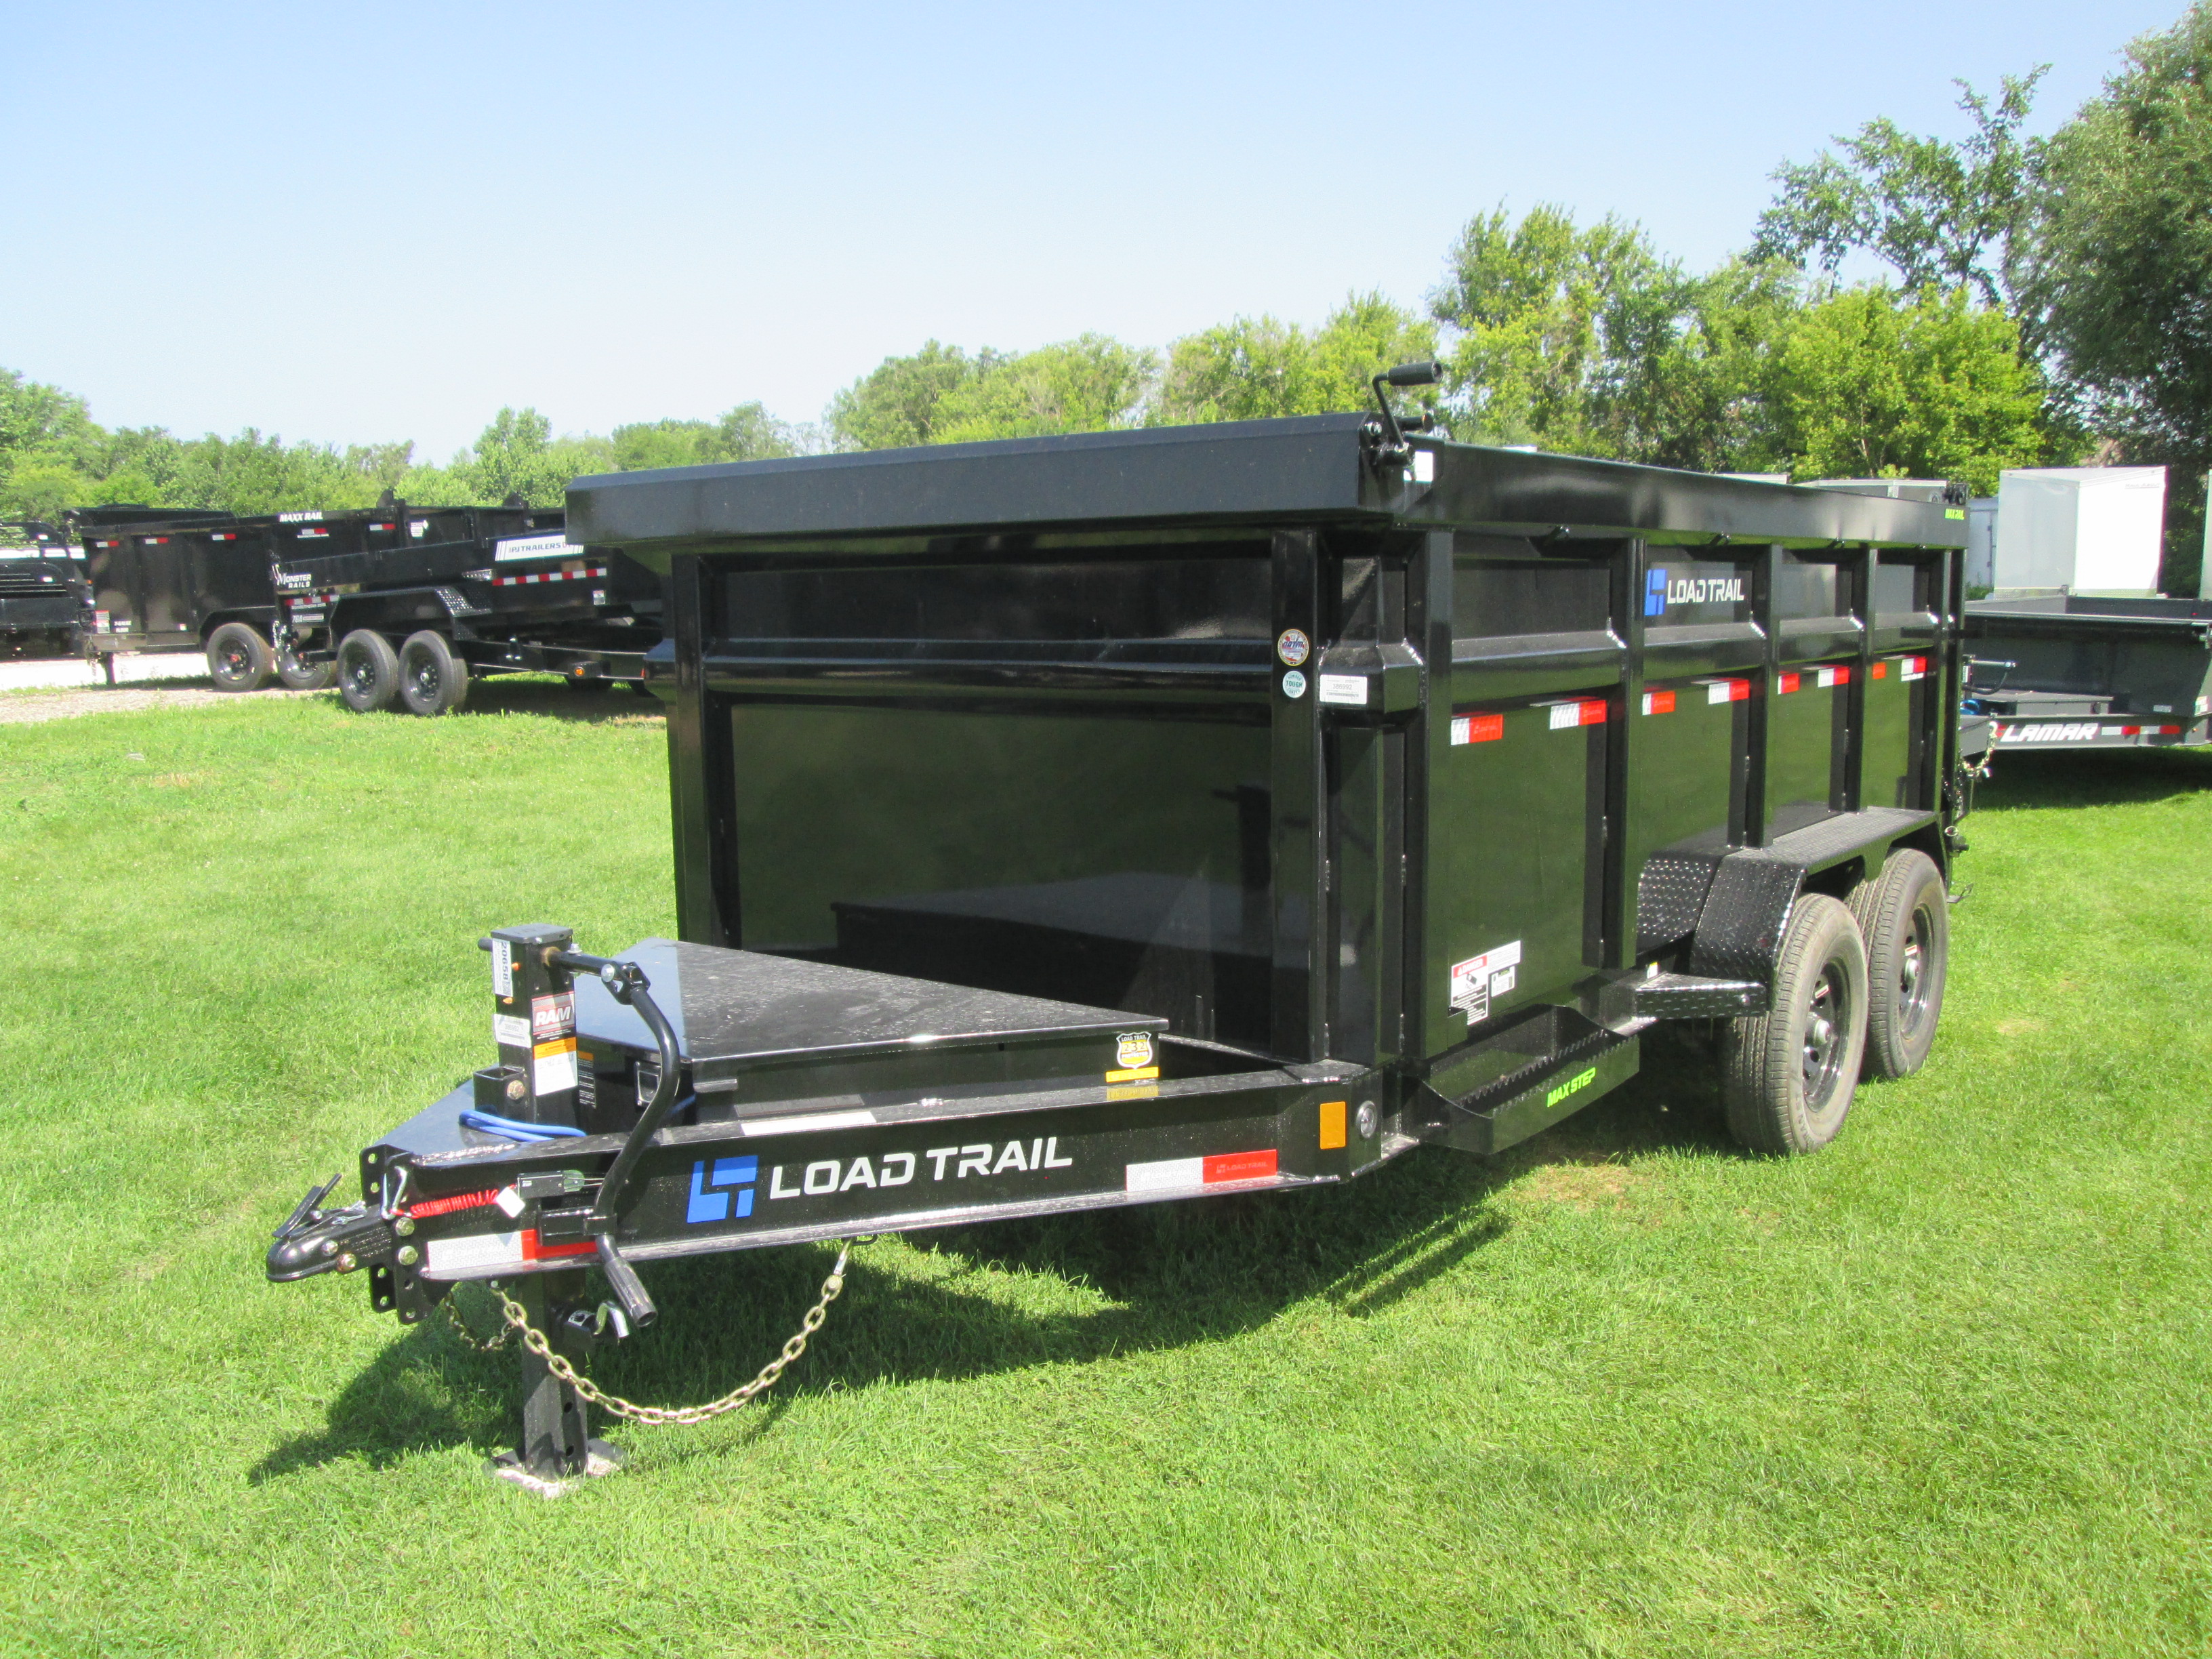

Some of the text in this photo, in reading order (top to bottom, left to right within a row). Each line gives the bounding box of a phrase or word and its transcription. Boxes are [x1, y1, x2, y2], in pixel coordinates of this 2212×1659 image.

[279, 512, 323, 522] MAXX RAIL
[522, 542, 561, 552] TRAILERS
[276, 573, 312, 586] MONSTER
[1666, 579, 1706, 604] LOAD
[1708, 579, 1745, 602] TRAIL
[1286, 680, 1303, 688] TOUGH
[2001, 723, 2098, 742] LAMAR
[535, 1006, 571, 1027] RAM
[1547, 1067, 1596, 1107] MAX STEP
[769, 1152, 916, 1200] LOAD
[926, 1136, 1073, 1181] TRAIL
